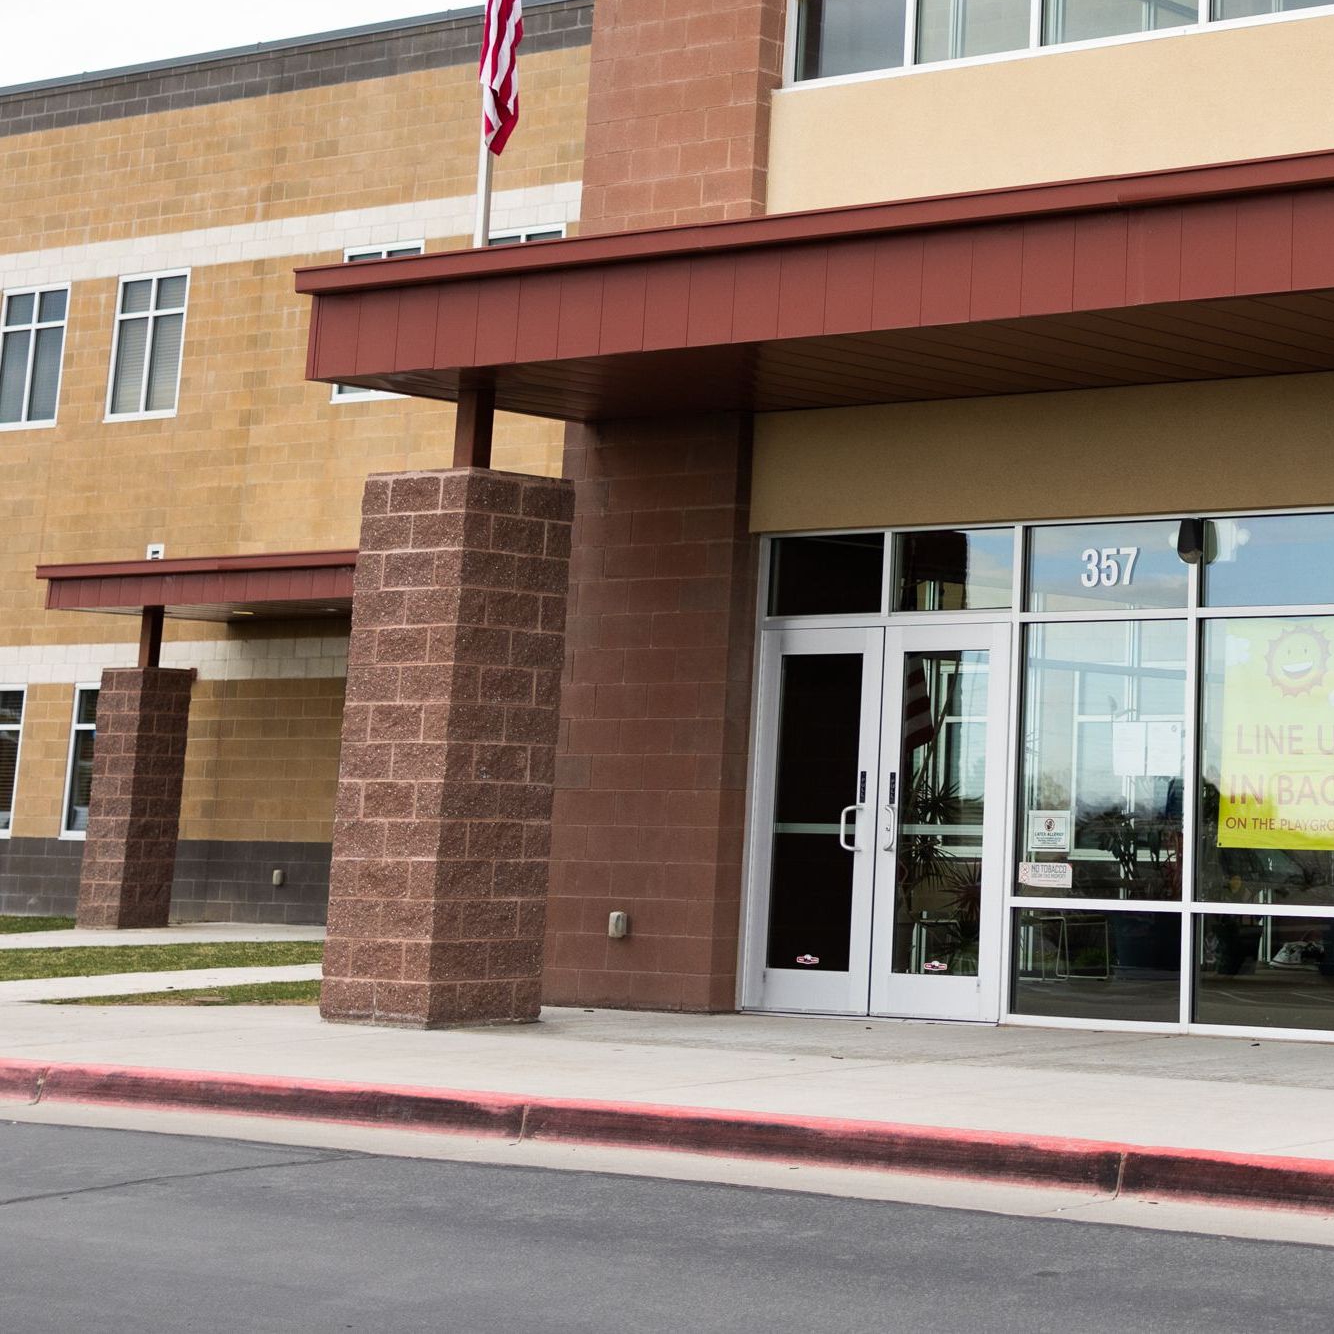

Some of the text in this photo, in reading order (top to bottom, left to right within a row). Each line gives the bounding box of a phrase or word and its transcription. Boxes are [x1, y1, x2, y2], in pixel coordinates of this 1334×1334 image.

[1081, 546, 1139, 587] 357
[1237, 724, 1303, 755] LINE
[1230, 775, 1264, 805] IN
[1226, 817, 1247, 830] ON
[1252, 818, 1276, 831] THE
[1031, 864, 1067, 874] NO TOBACCO
